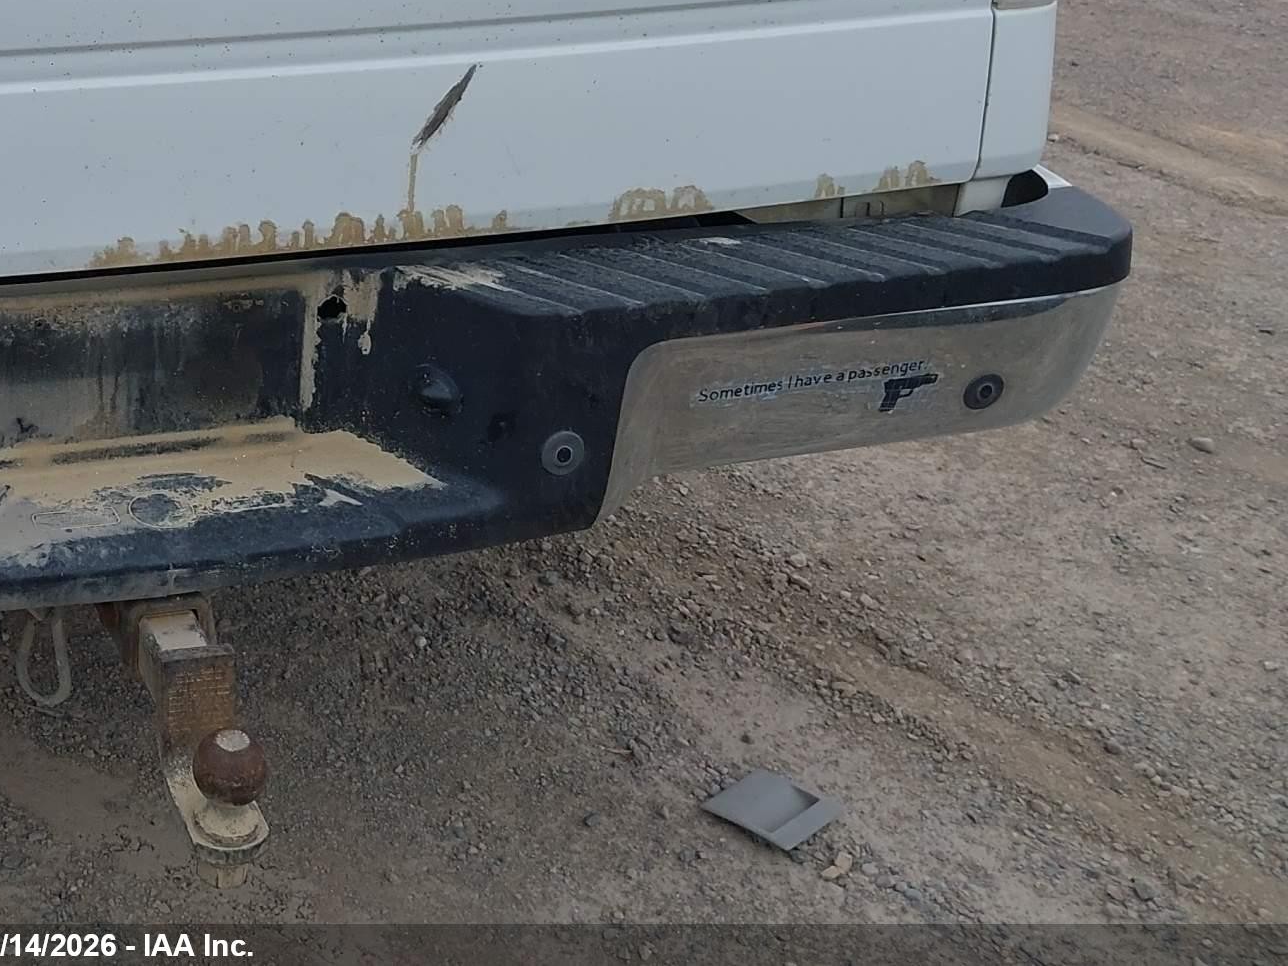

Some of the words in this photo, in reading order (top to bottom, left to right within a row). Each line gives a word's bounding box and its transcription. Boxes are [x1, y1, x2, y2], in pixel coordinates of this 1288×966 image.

[698, 380, 783, 402] Sometimes
[795, 373, 832, 387] have
[836, 372, 844, 381] a
